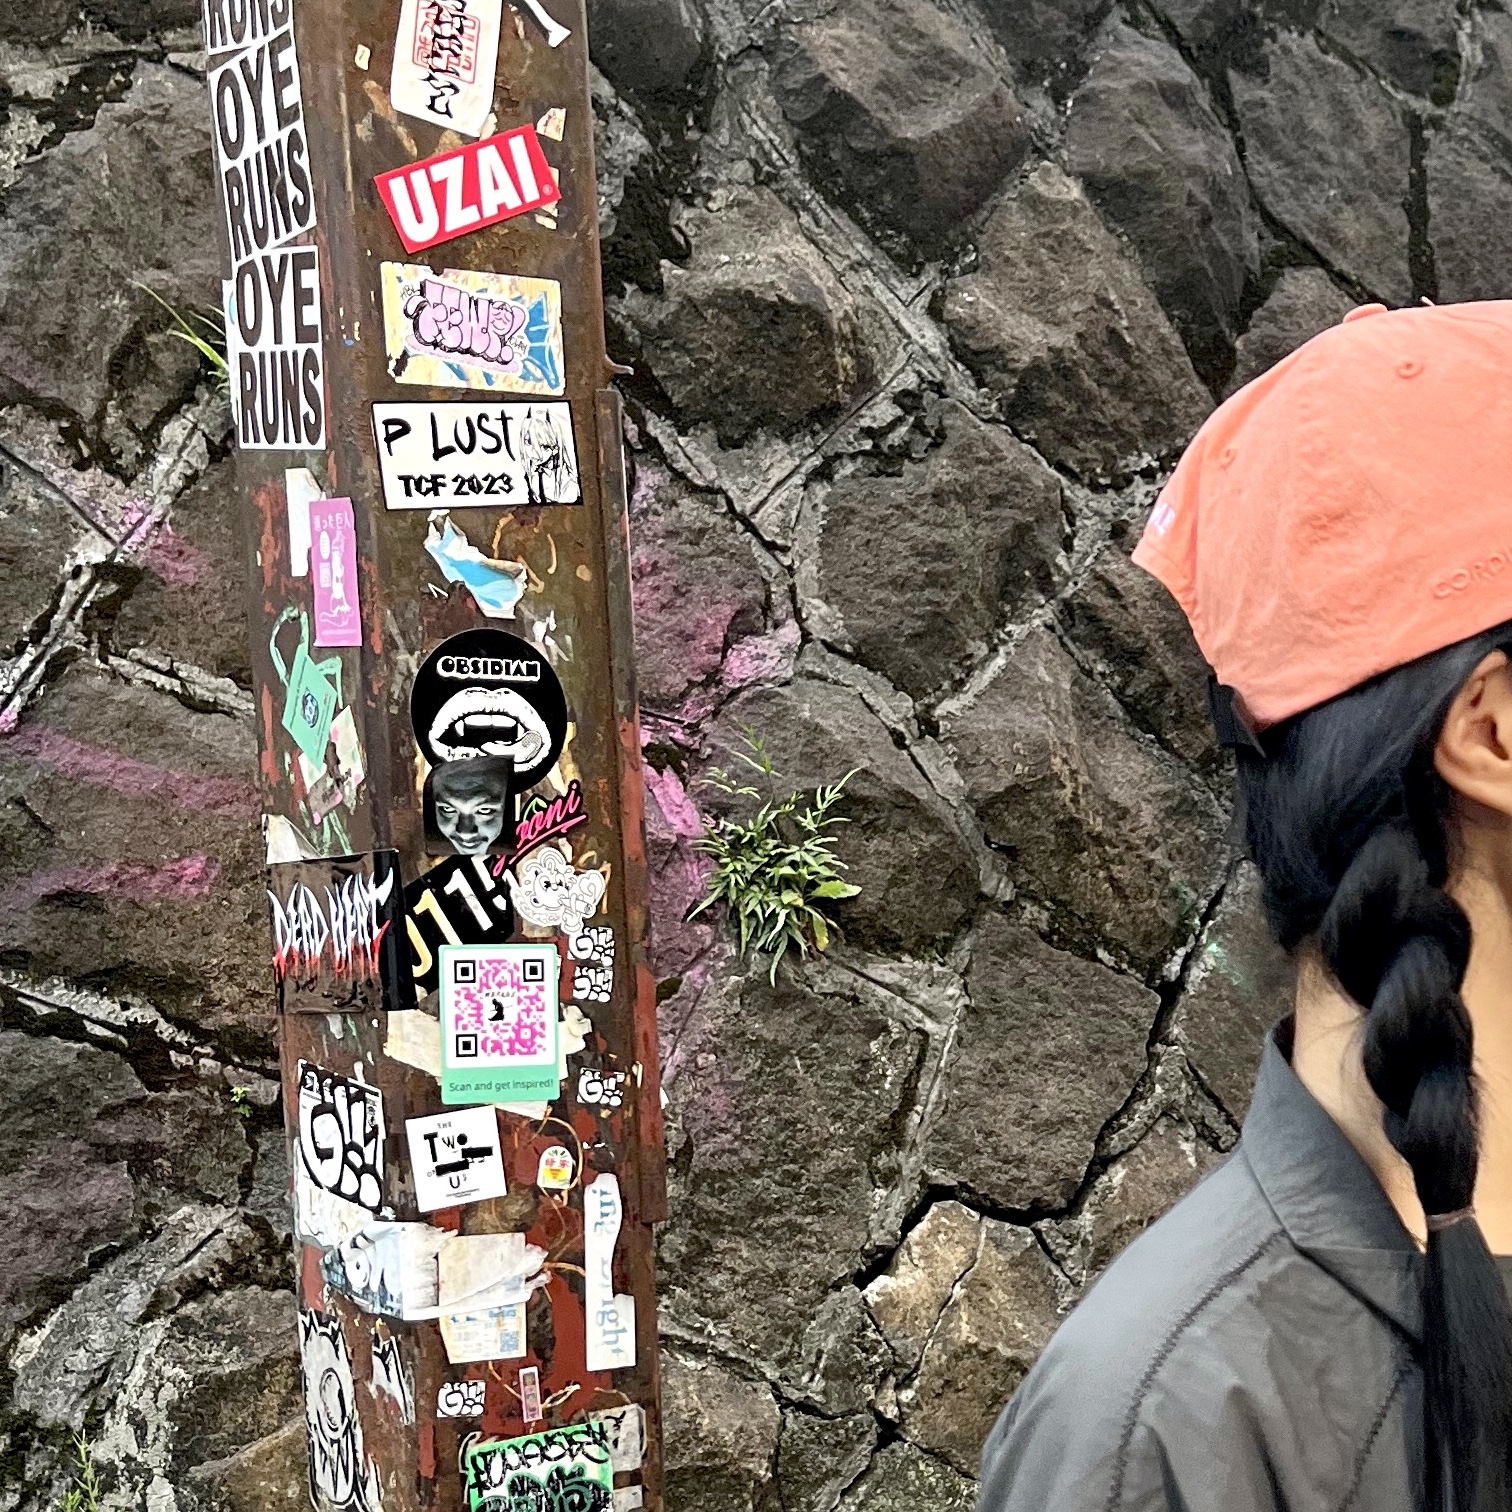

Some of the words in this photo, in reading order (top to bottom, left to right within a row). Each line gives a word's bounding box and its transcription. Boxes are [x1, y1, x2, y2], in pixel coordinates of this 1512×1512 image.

[216, 29, 300, 161] OYE
[224, 129, 311, 262] RUNS
[388, 134, 541, 243] UZAI
[236, 251, 319, 347] OYE
[239, 347, 322, 445] RUNS
[382, 417, 412, 457] P
[429, 409, 517, 462] LUST
[397, 474, 447, 497] TCF
[451, 473, 515, 496] 2023
[438, 656, 541, 680] OBSIDIAN
[449, 1082, 472, 1092] Scan
[474, 1081, 492, 1091] and
[494, 1081, 511, 1092] get
[513, 1079, 554, 1090] inspired!
